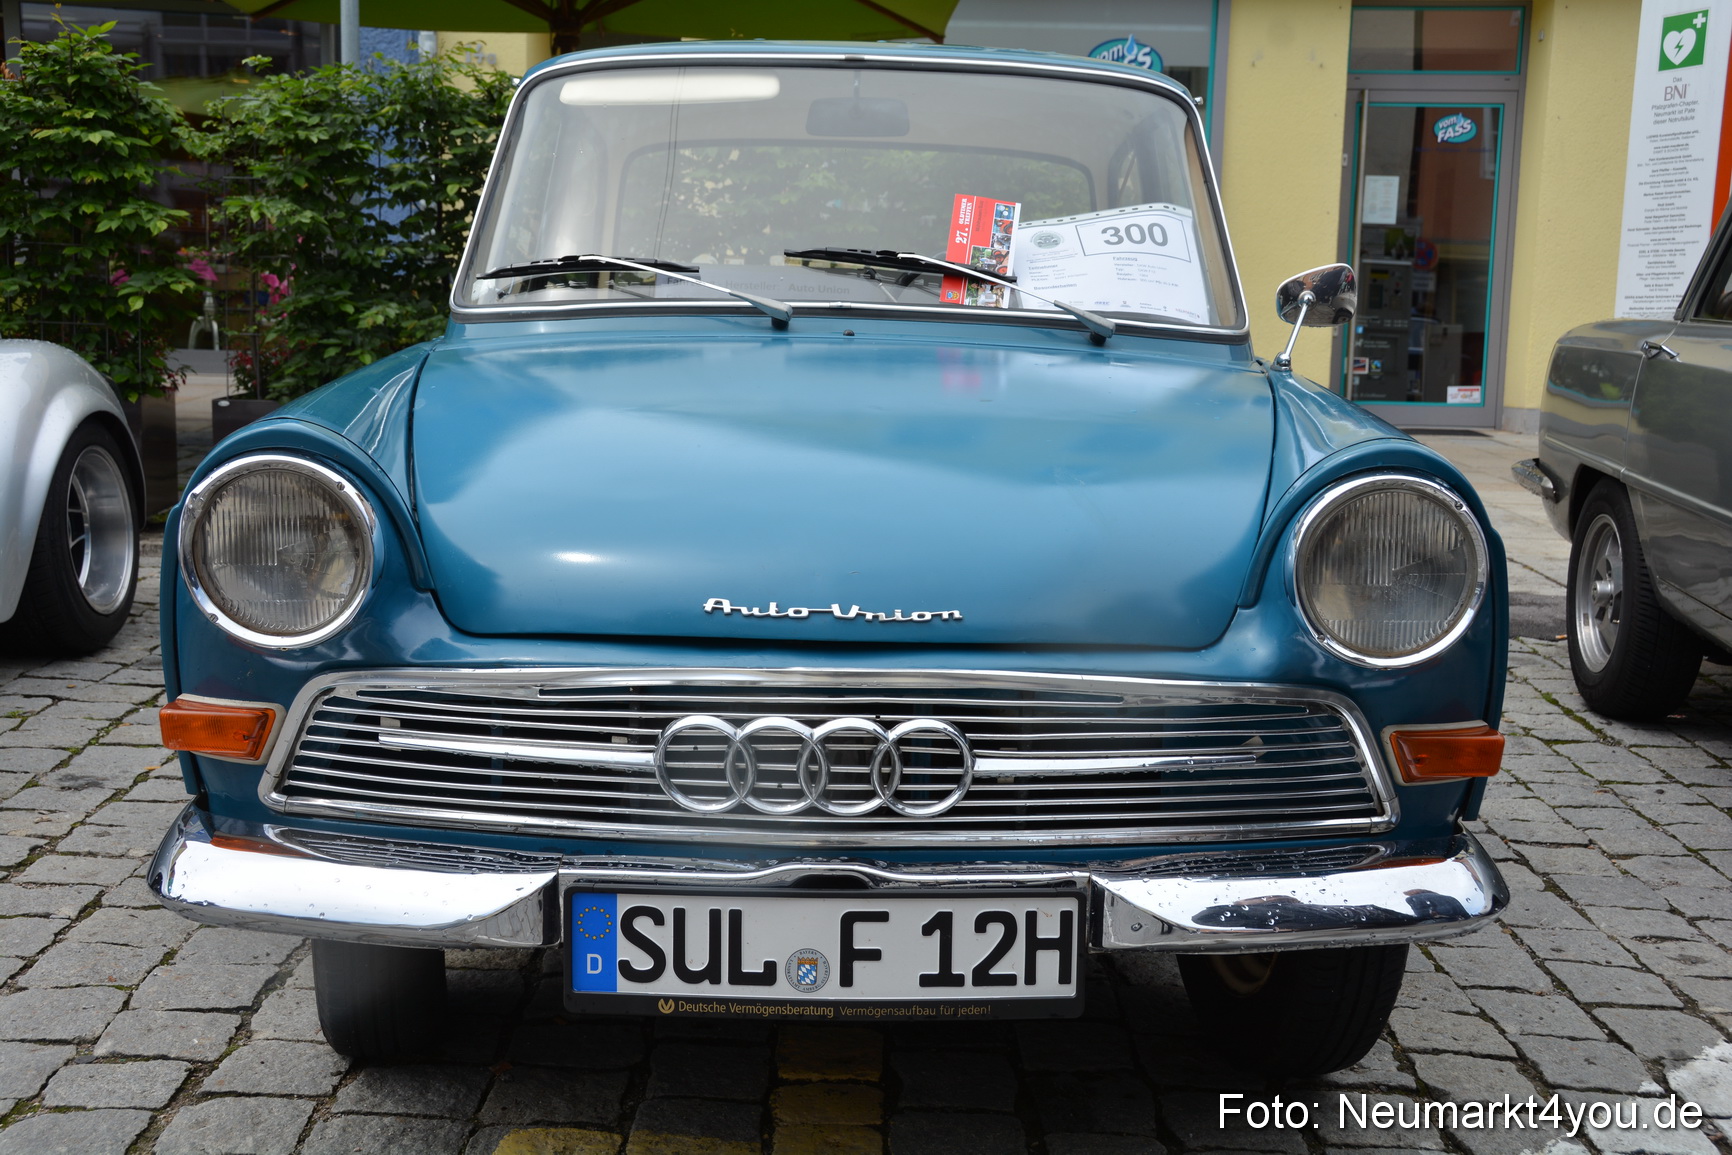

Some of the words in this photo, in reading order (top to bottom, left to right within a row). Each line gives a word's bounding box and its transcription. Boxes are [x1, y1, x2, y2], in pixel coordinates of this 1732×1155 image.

[1664, 83, 1687, 101] BNI
[1439, 116, 1457, 129] vom
[1653, 110, 1677, 118] Neumarkt
[1653, 118, 1667, 126] dieser
[1668, 115, 1695, 124] Notrufsäule
[1437, 119, 1472, 143] FASS
[964, 202, 973, 225] TREFFEN
[955, 227, 969, 244] 27.
[1101, 223, 1168, 247] 300
[788, 284, 815, 293] Auto
[818, 284, 850, 294] Union
[703, 597, 810, 619] Auto
[831, 603, 963, 622] Union
[618, 905, 777, 987] SUL
[840, 911, 890, 988] F
[919, 910, 1074, 988] 12H
[586, 953, 603, 975] D
[679, 1000, 726, 1014] Deutsche
[728, 1001, 834, 1018] Vermögensberatung
[840, 1005, 936, 1019] Vermögensaufbau
[939, 1004, 955, 1017] für
[957, 1005, 991, 1019] jeden!
